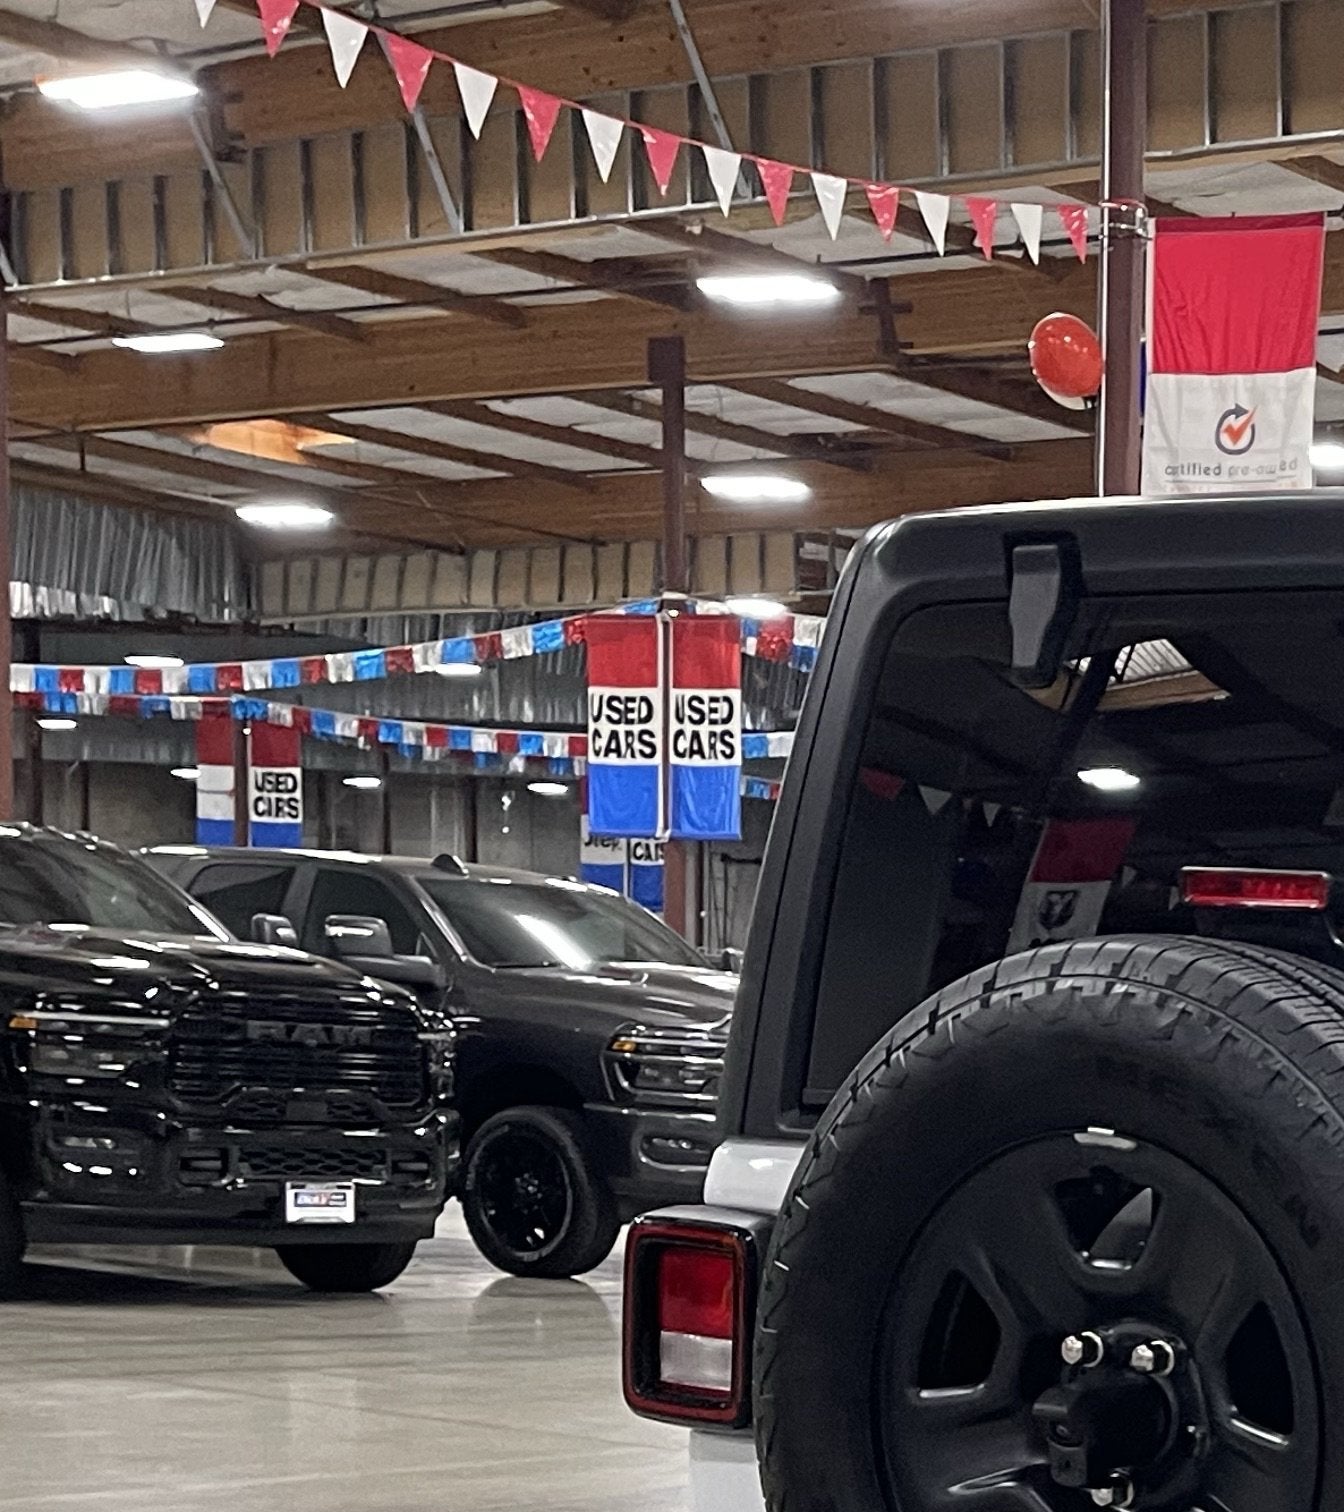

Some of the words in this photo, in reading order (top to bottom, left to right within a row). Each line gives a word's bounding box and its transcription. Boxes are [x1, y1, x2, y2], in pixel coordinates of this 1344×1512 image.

[591, 694, 654, 726] USED
[675, 694, 734, 726] USED
[592, 729, 657, 760] CARS
[673, 729, 735, 760] CARS
[254, 771, 298, 794] USED
